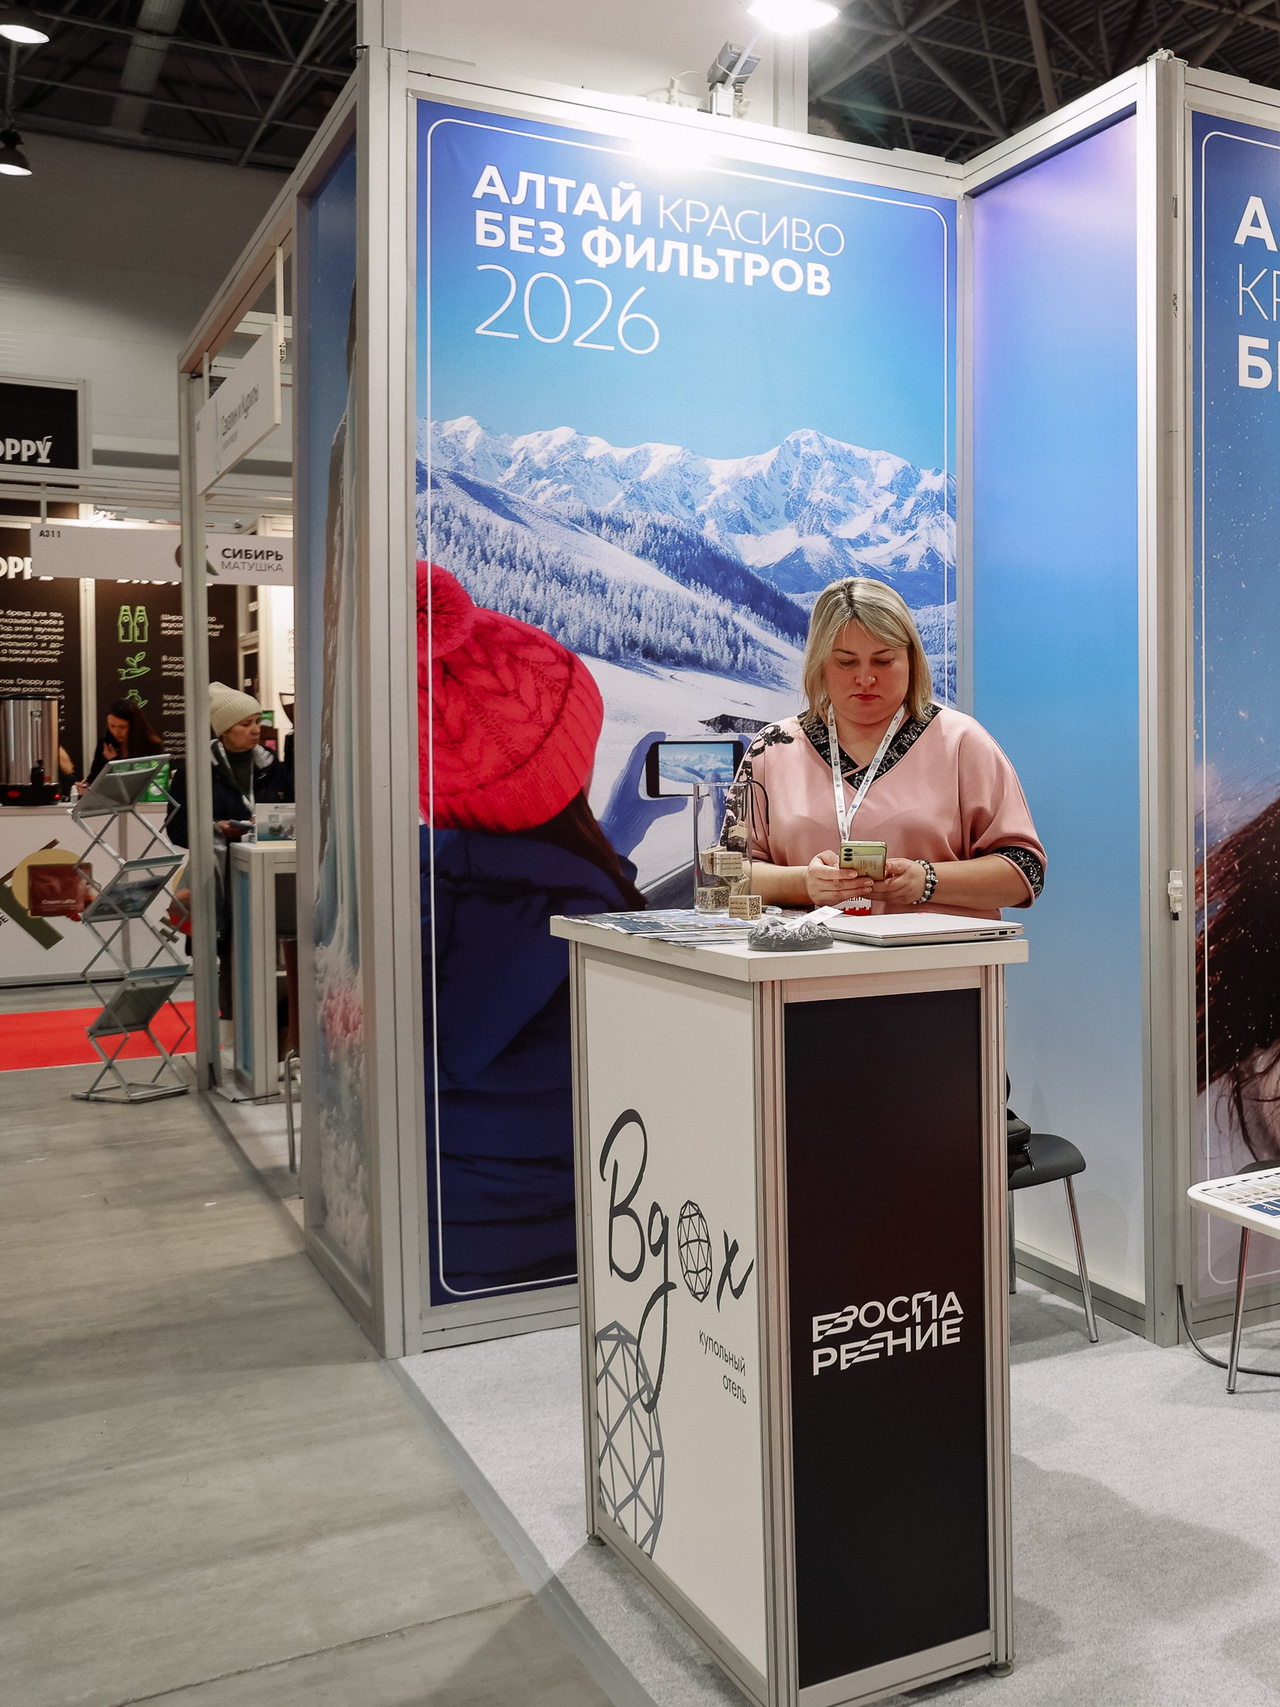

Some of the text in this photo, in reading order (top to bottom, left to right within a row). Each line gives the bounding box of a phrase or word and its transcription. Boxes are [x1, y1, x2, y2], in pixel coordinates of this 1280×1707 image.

[472, 164, 845, 257] АЛТАЙ КРАСИВО
[475, 210, 832, 296] БЕЗ ФИЛЬТРОВ
[475, 264, 660, 355] 2026
[221, 548, 284, 561] СИБИРЬ
[221, 560, 284, 572] МАТУШКА
[699, 1329, 747, 1376] купольный
[722, 1376, 747, 1405] отель
